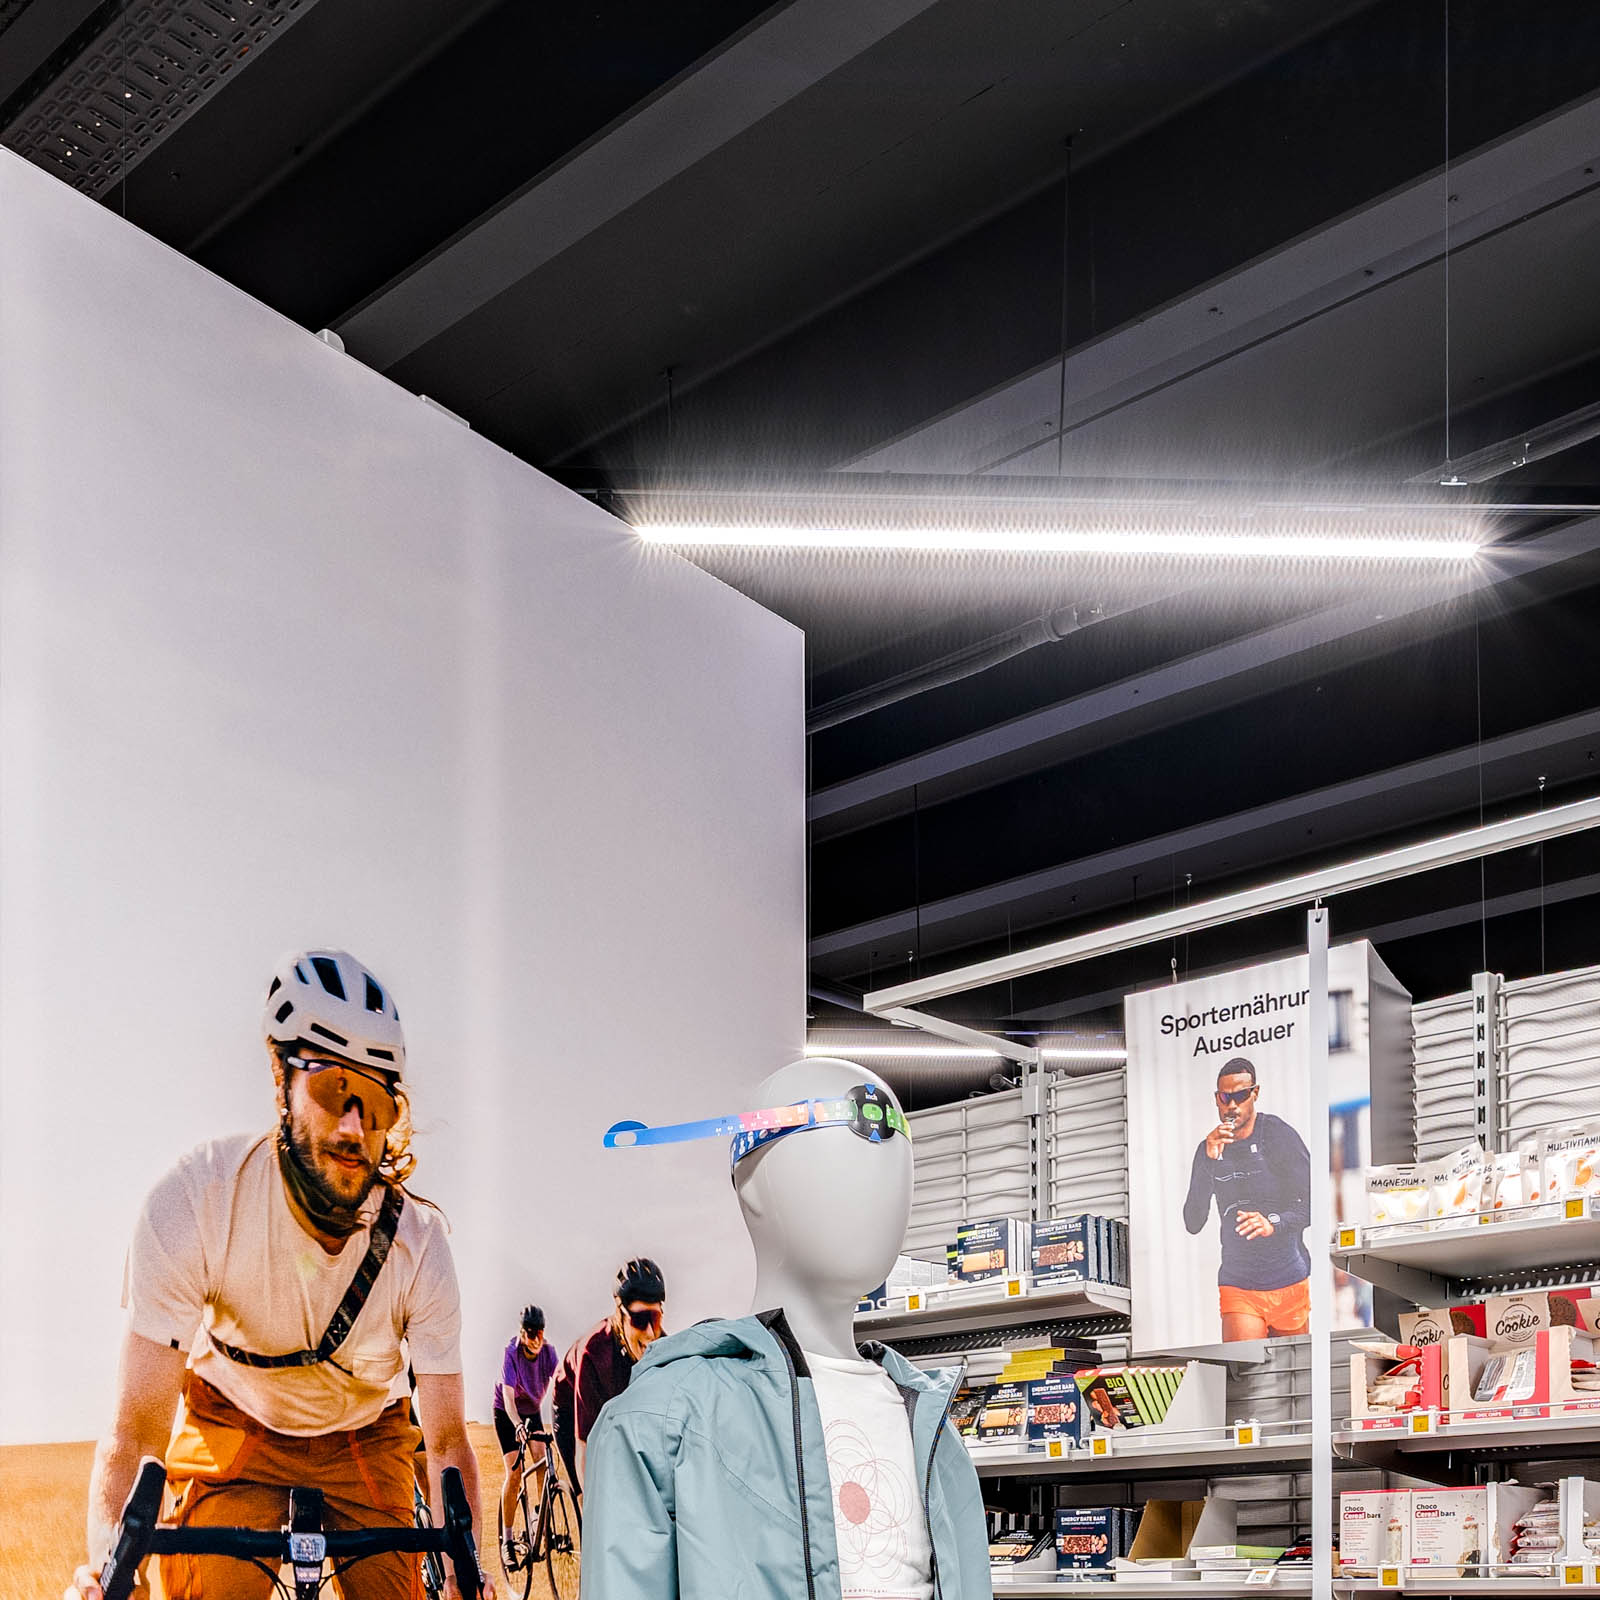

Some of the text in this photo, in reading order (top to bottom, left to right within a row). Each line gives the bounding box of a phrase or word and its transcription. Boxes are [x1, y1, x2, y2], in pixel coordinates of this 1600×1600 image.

[1193, 1018, 1295, 1058] Ausdauer
[1370, 1178, 1419, 1188] MAGNESIUM
[1069, 1222, 1082, 1231] BARS
[1495, 1313, 1541, 1336] Cookie
[1105, 1377, 1125, 1388] BIO
